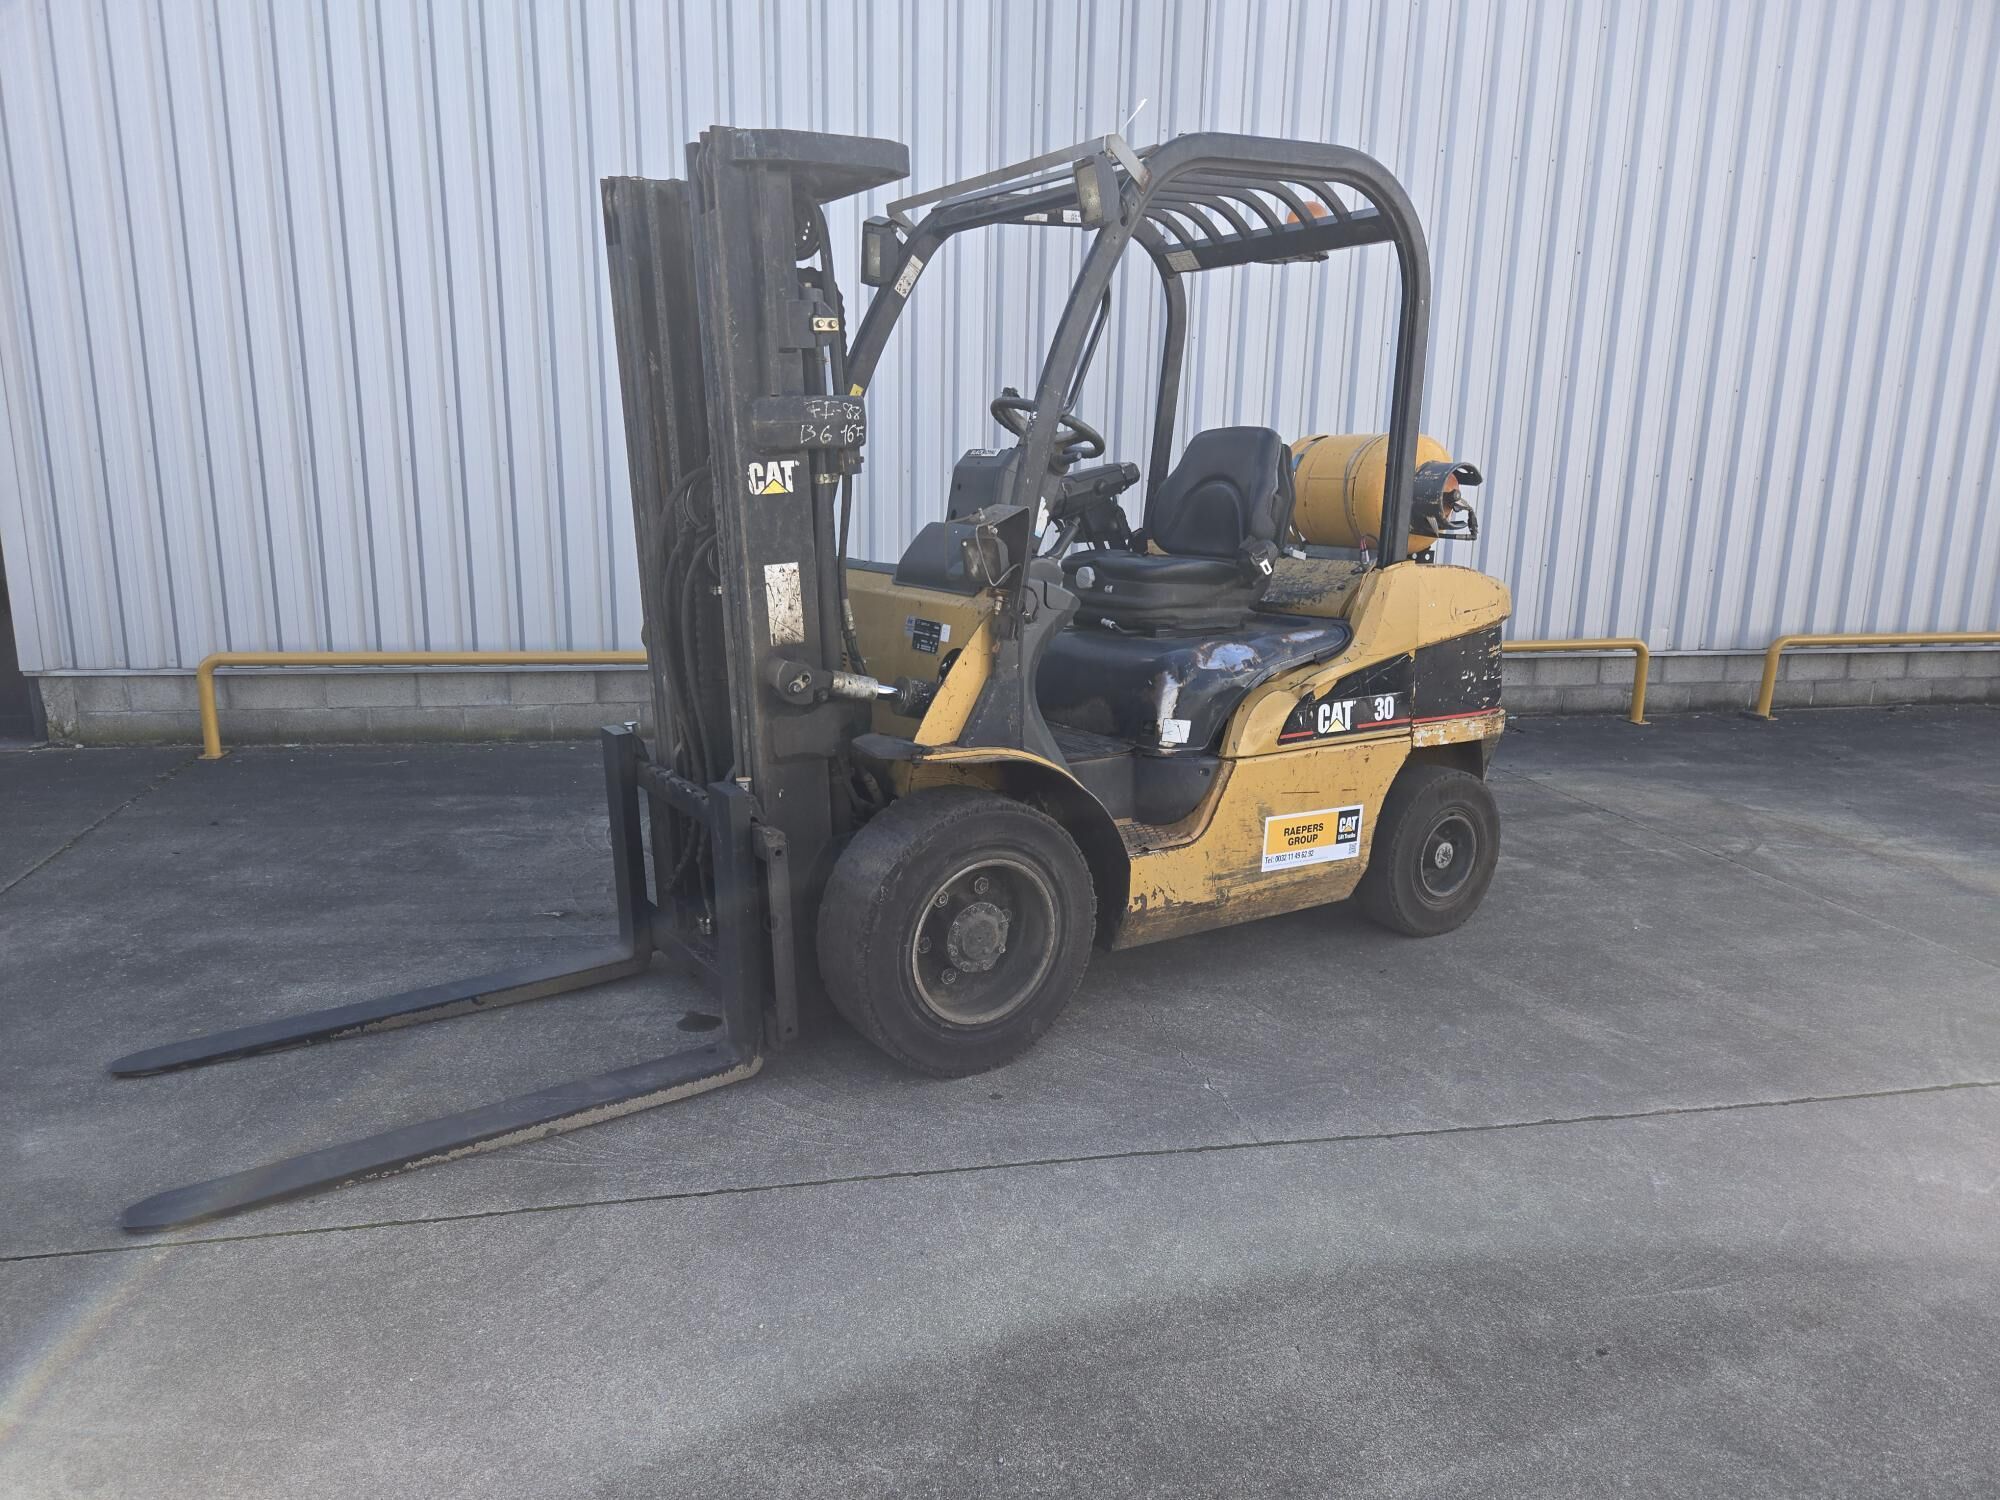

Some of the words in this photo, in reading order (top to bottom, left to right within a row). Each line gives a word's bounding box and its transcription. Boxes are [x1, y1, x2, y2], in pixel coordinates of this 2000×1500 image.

[748, 460, 795, 495] CAT
[1317, 700, 1354, 734] CAT
[1374, 695, 1395, 722] 30
[1283, 822, 1324, 837] RAEPERS
[1339, 815, 1359, 833] CAT
[1287, 834, 1319, 846] GROUP
[1264, 856, 1275, 864] Tel:
[1274, 854, 1287, 863] 0032
[1288, 852, 1294, 861] 11
